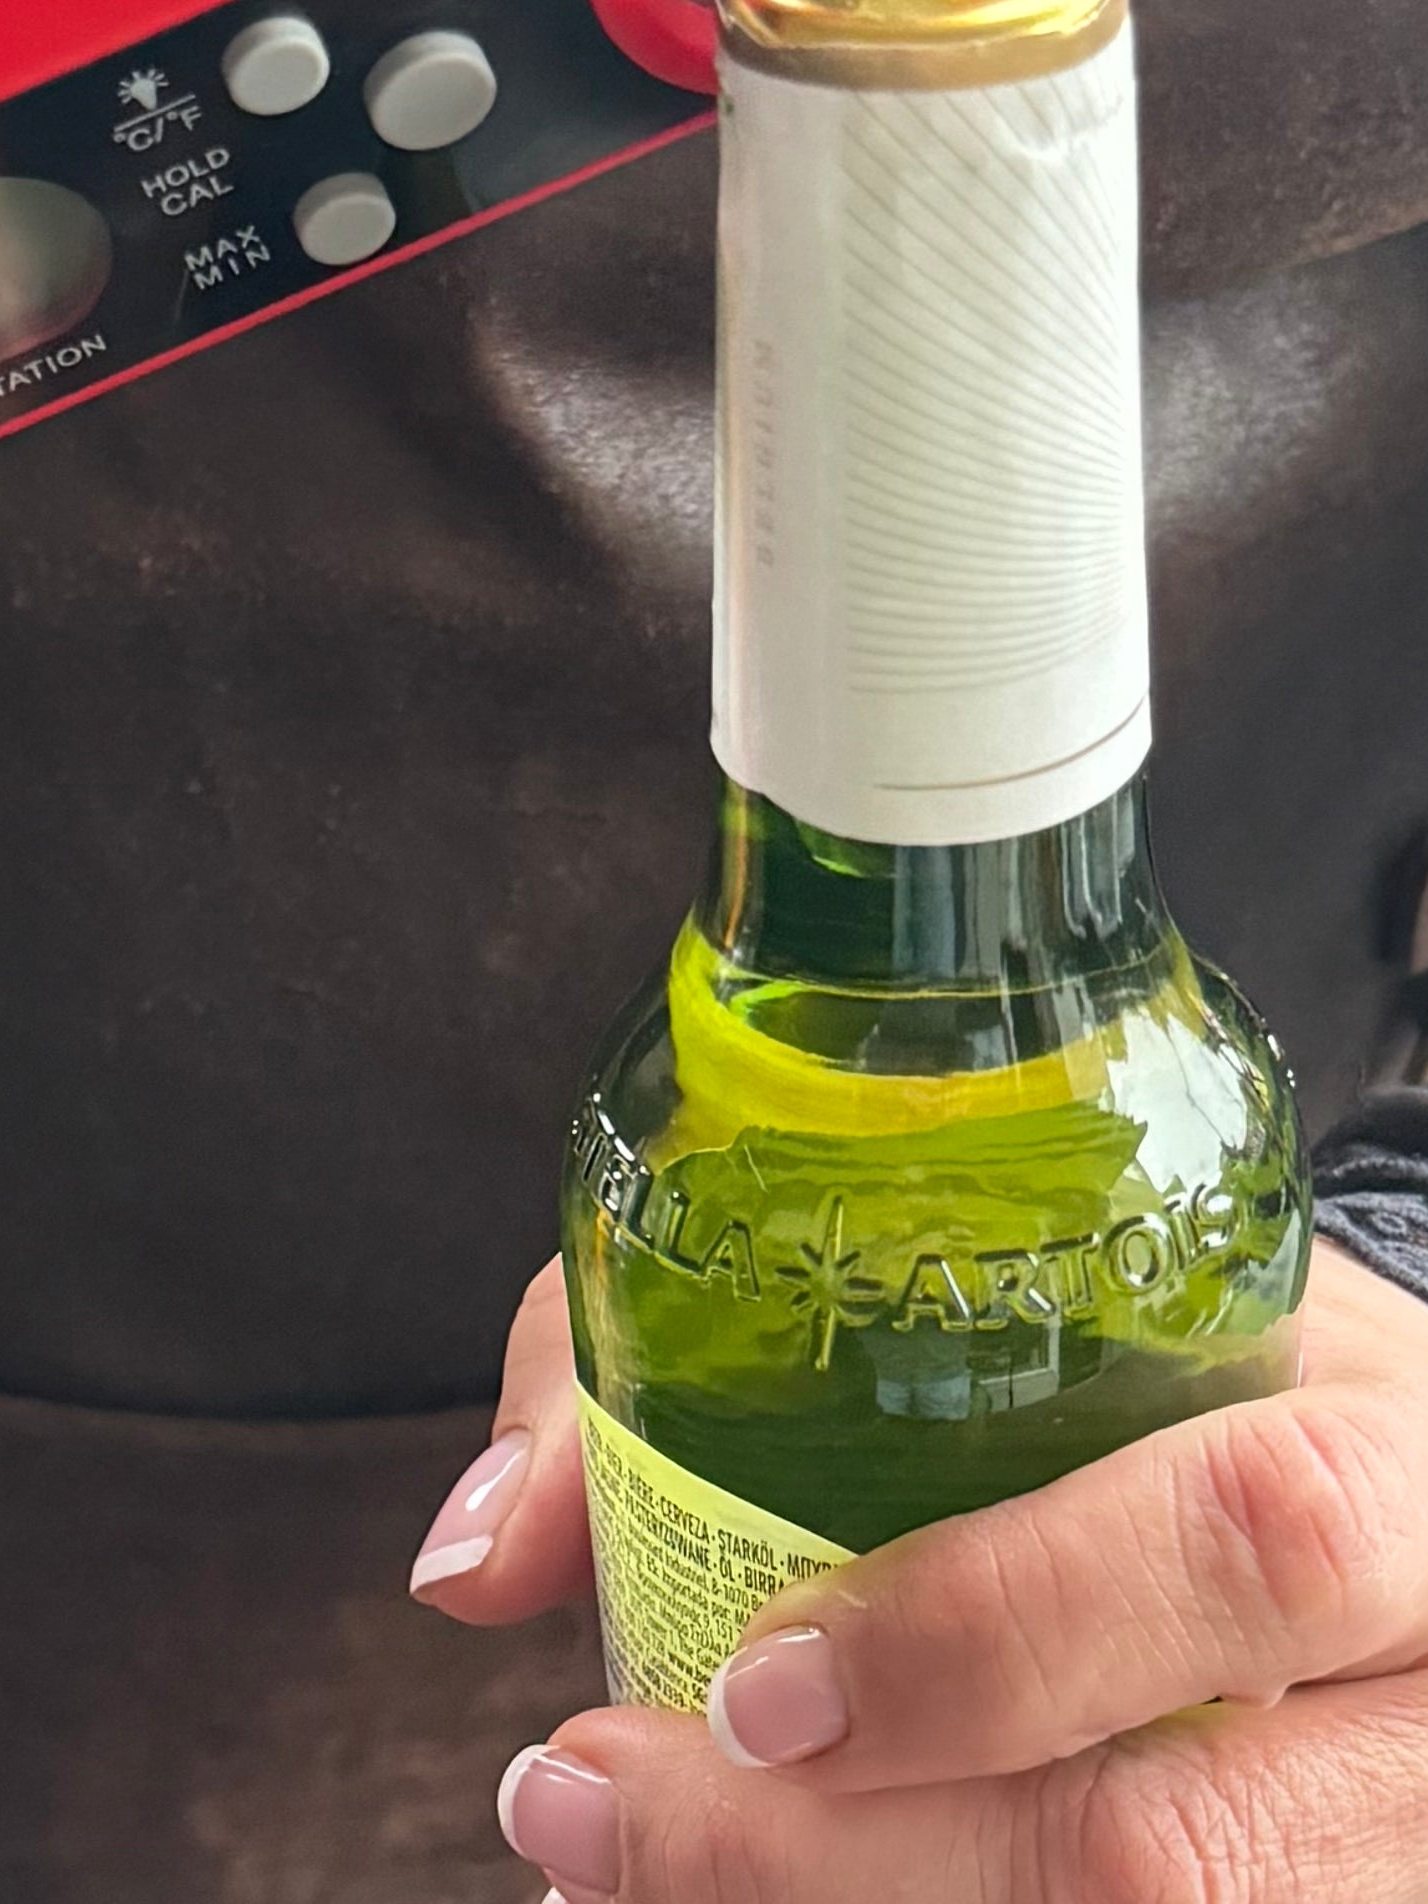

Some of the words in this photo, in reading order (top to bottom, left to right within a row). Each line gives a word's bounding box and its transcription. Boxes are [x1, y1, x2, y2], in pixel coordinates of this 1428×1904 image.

[140, 148, 230, 198] HOLD
[161, 175, 234, 216] CAL
[184, 225, 260, 271] MAX
[193, 244, 270, 290] MIN
[891, 1183, 1236, 1333] ARTOIS
[660, 1495, 710, 1544] CERVEZA
[718, 1528, 777, 1572] STARKÖL
